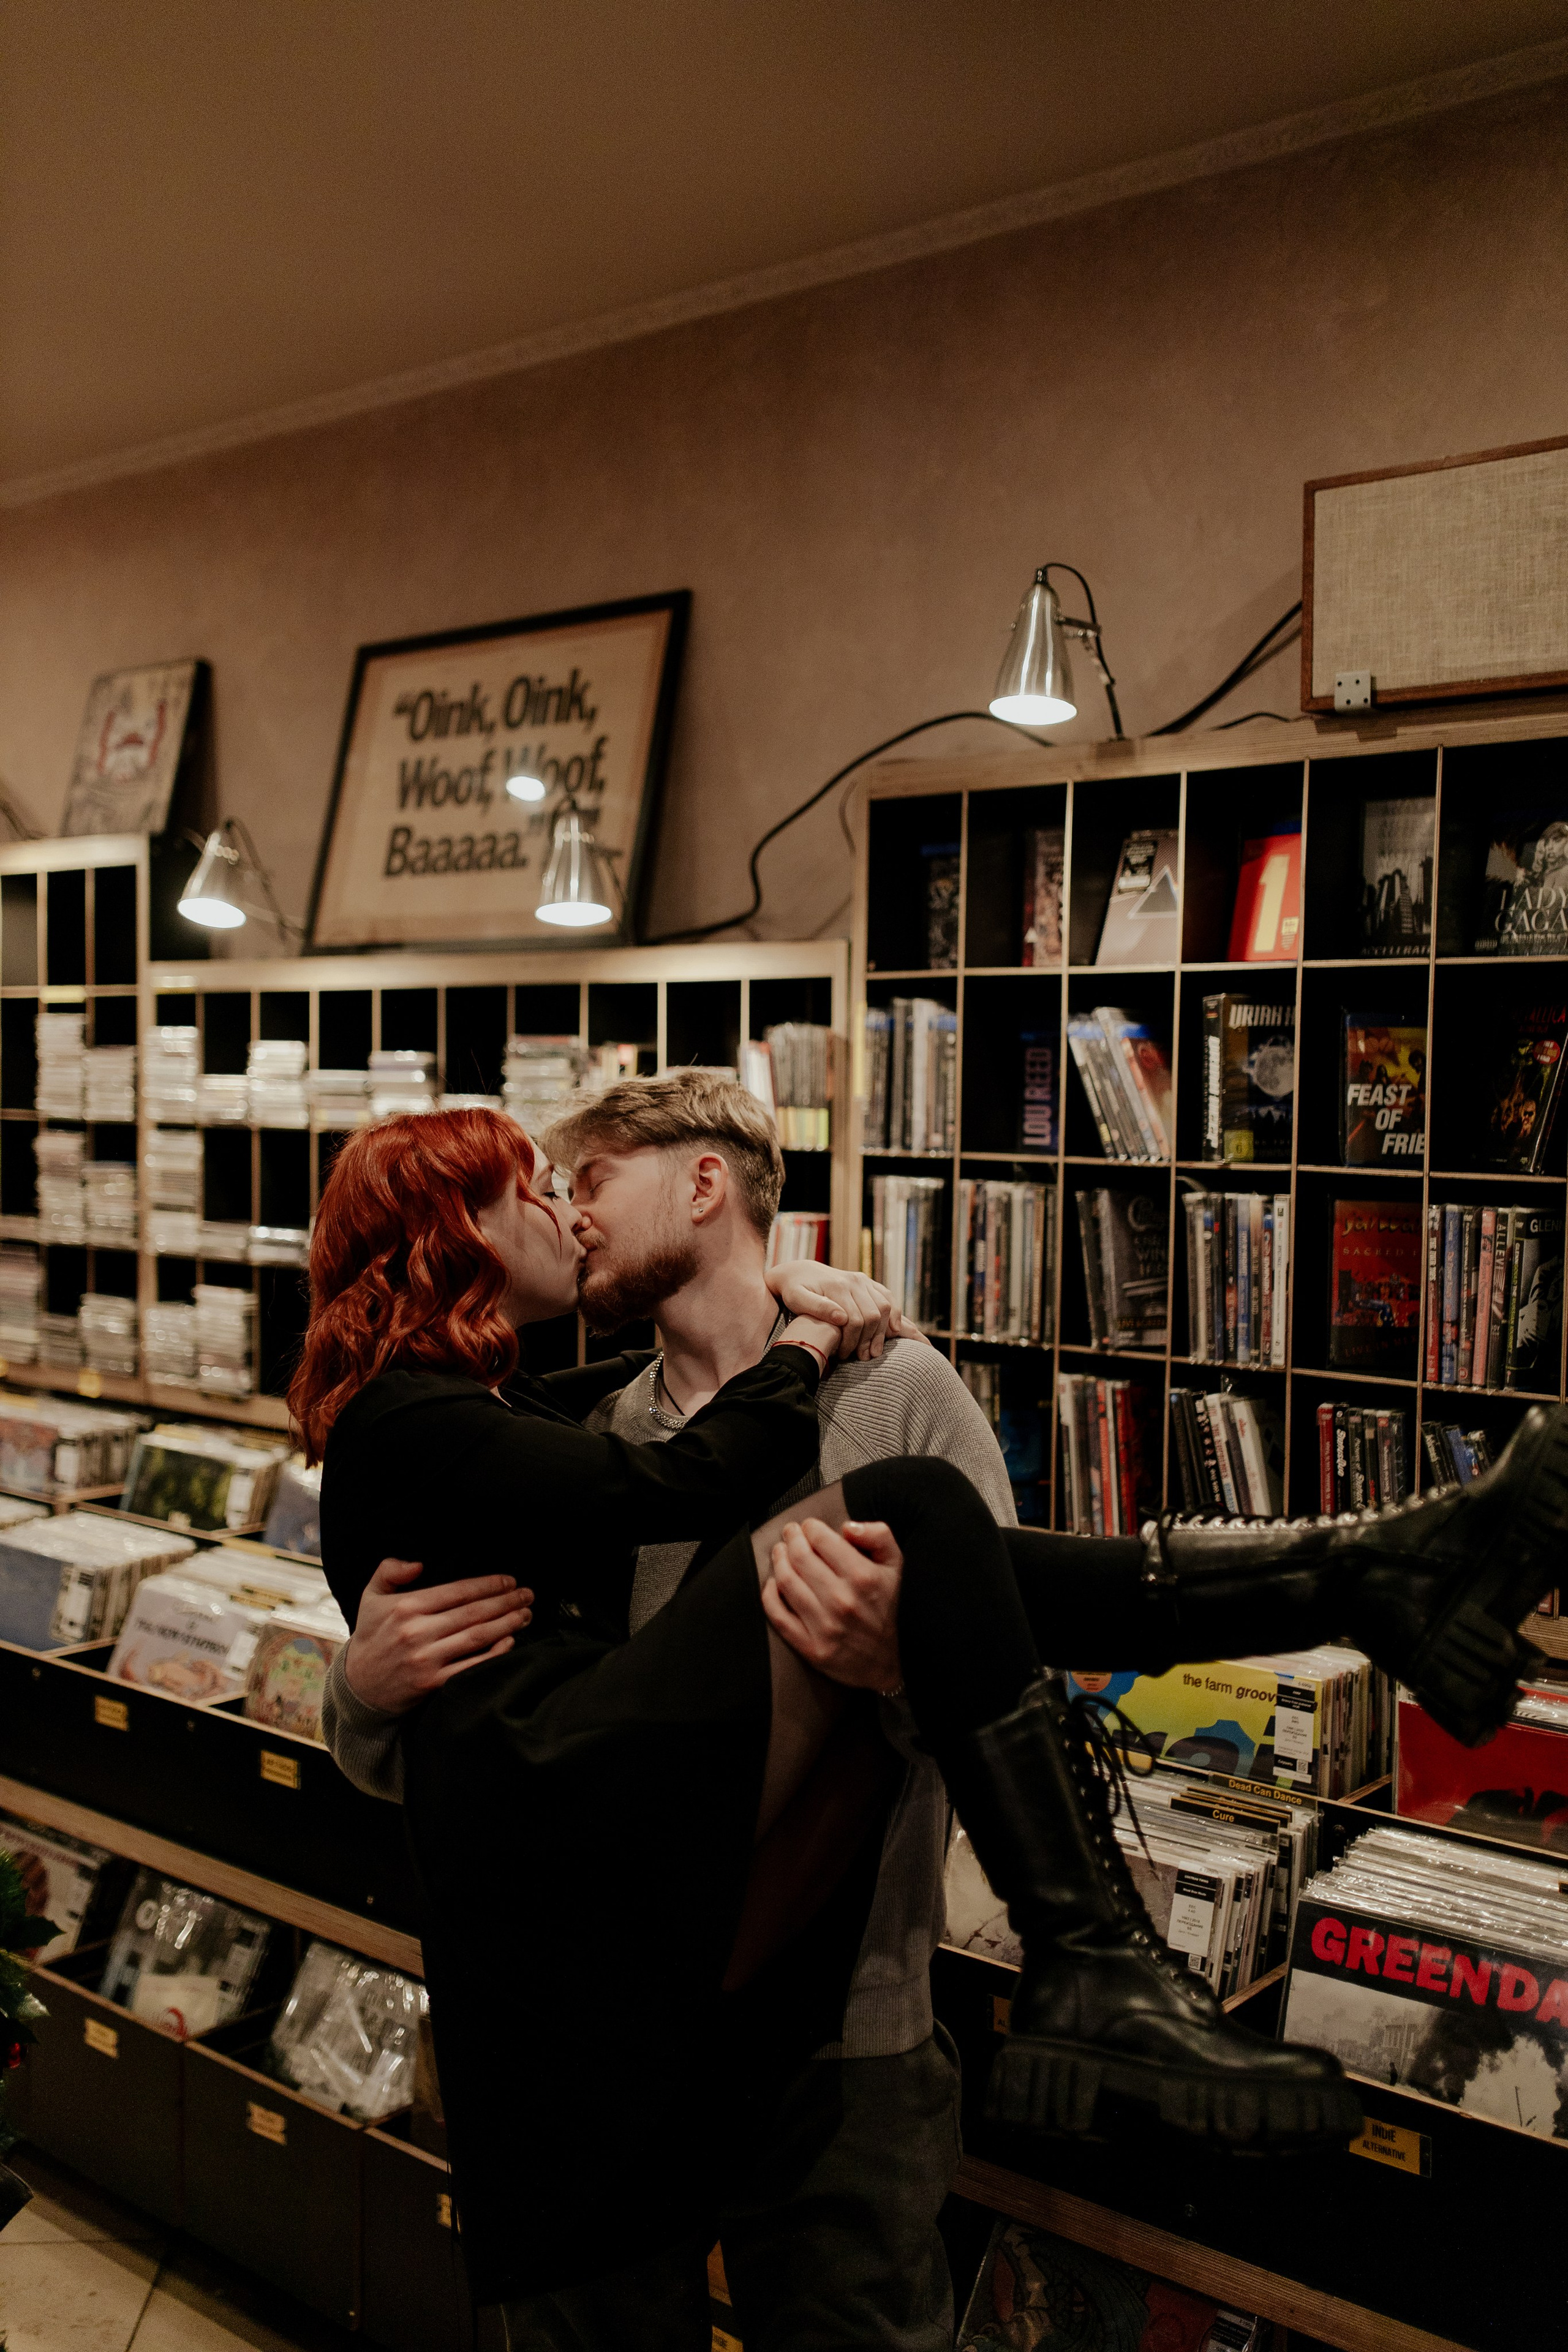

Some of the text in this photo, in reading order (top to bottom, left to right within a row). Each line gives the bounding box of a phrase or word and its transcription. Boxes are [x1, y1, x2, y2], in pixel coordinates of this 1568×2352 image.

[503, 667, 599, 733] Oink,
[397, 748, 496, 816] Woof,
[1253, 854, 1291, 953] 1
[1500, 887, 1568, 913] LADY
[1494, 909, 1568, 933] GAGA
[1228, 1004, 1283, 1029] URIAH
[1023, 1047, 1052, 1146] LOU REED
[1348, 1084, 1411, 1106] FEAST
[1375, 1108, 1403, 1131] OF
[1382, 1133, 1425, 1155] FRIE
[1183, 1673, 1202, 1687] the
[1204, 1678, 1232, 1694] farm
[1235, 1686, 1278, 1703] groov
[1228, 1778, 1303, 1806] Dead Can Dance
[1212, 1809, 1235, 1823] Cure
[1496, 1963, 1568, 2030] DA
[1372, 2124, 1396, 2143] INDIE
[1362, 2139, 1406, 2163] ALTERNATIVE
